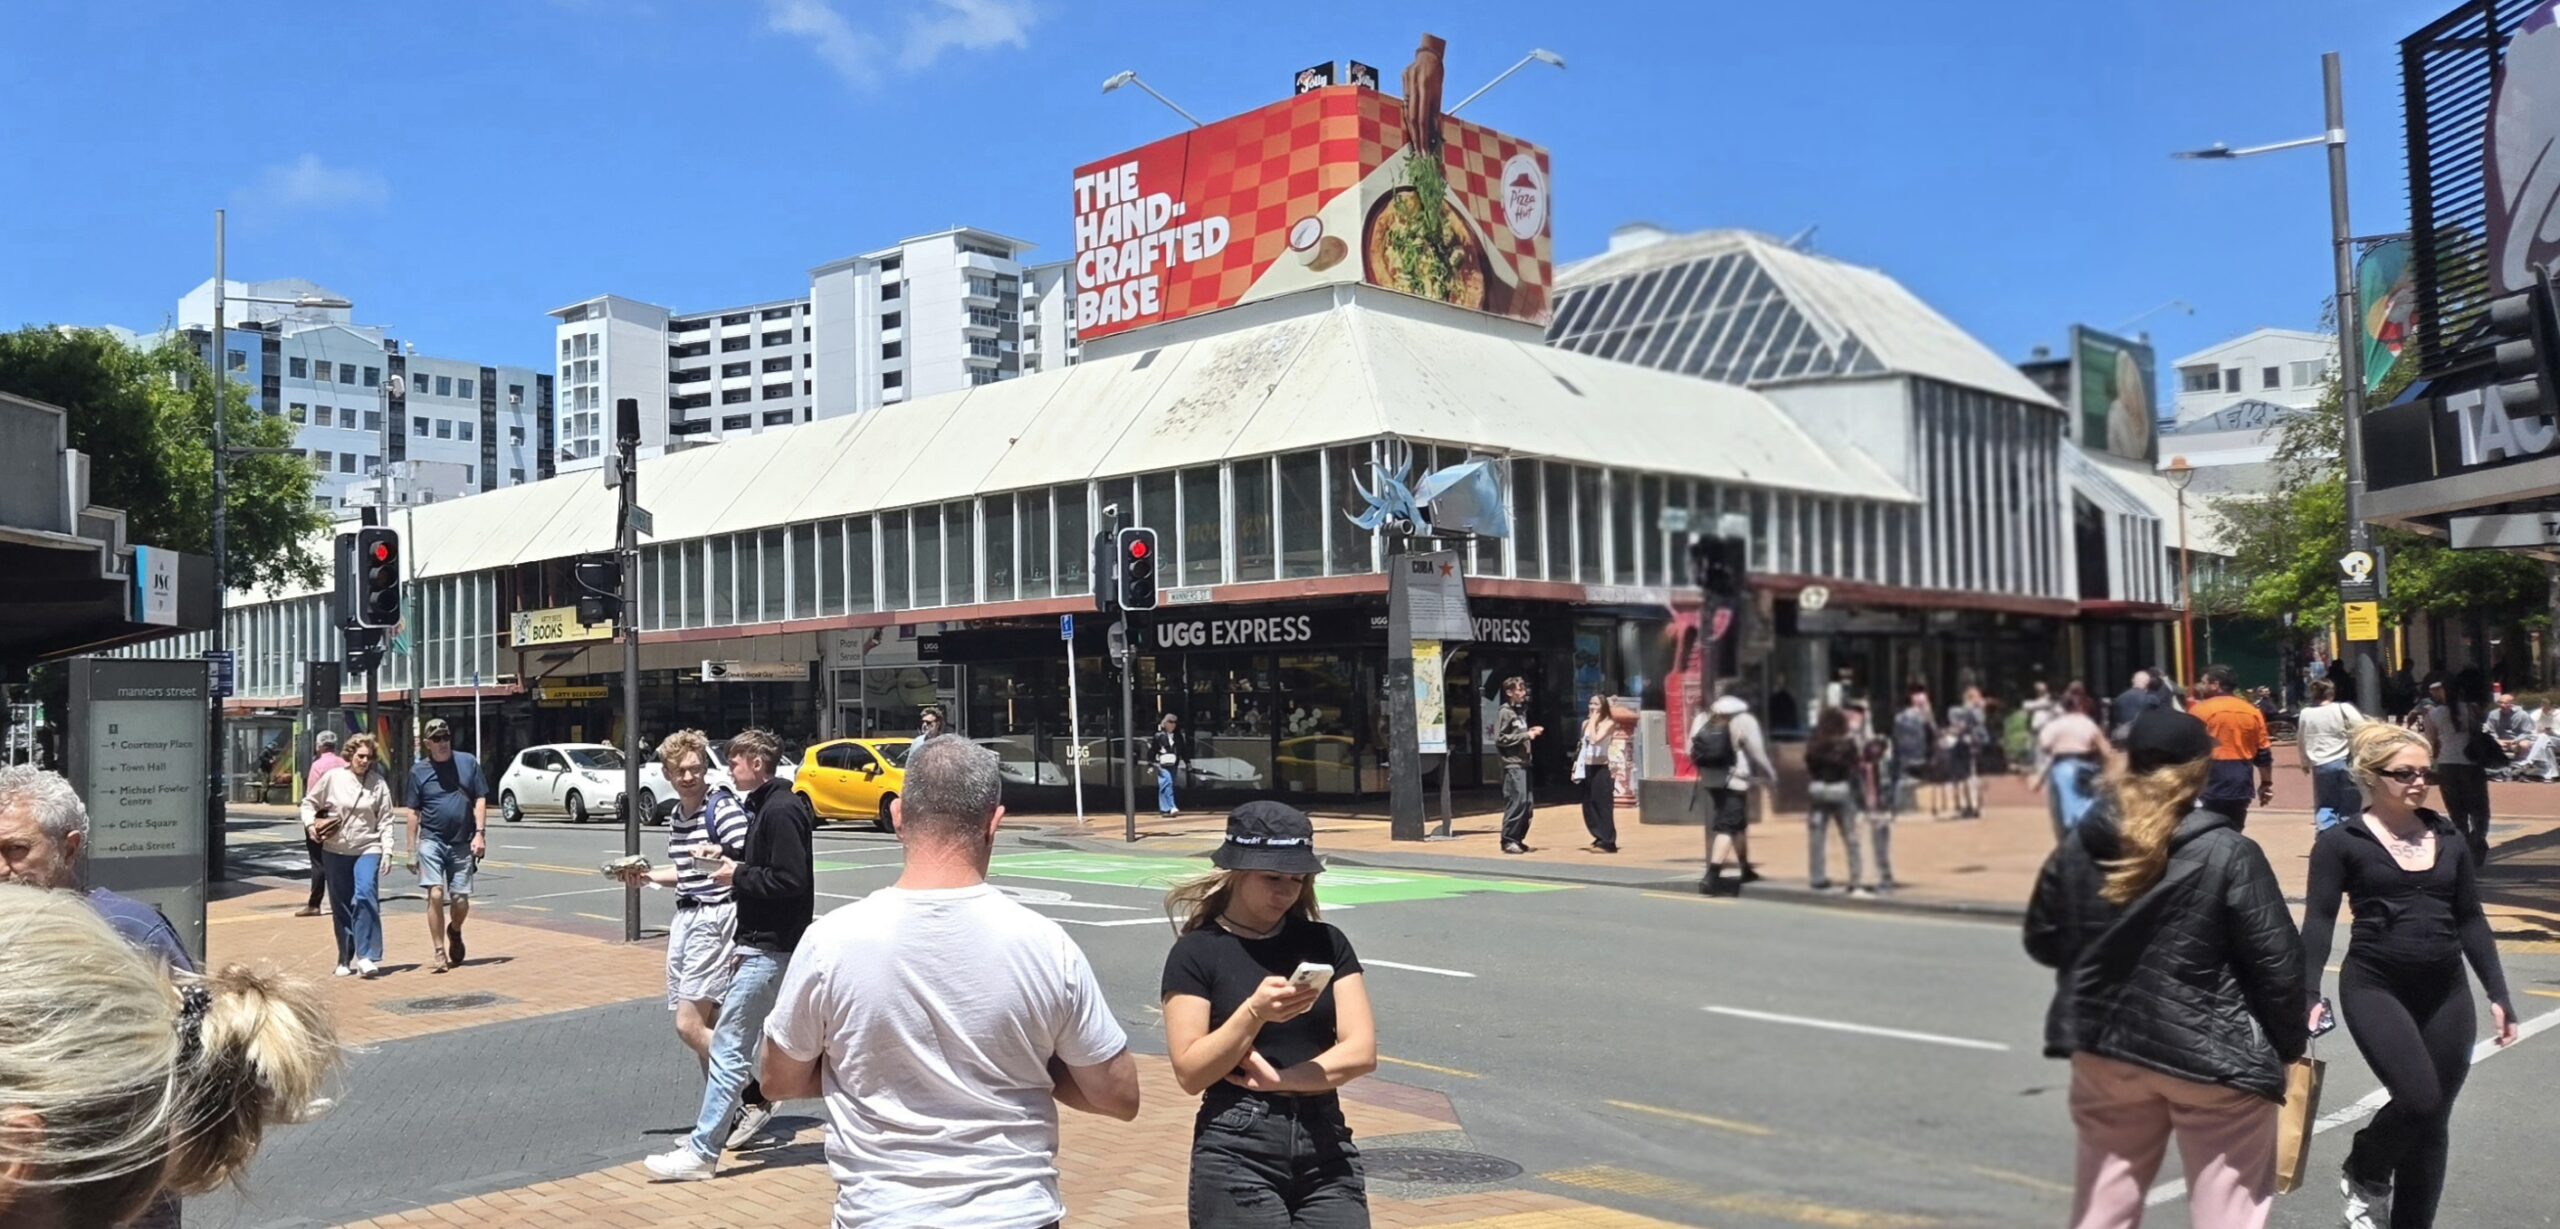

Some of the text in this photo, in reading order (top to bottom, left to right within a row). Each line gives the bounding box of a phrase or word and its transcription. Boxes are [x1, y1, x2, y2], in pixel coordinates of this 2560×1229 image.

[1075, 161, 1139, 213] THE
[1509, 189, 1536, 209] Pizza
[1076, 192, 1186, 253] HAND-
[1515, 206, 1534, 224] Hut
[1076, 216, 1230, 288] CRAFTED
[1078, 275, 1159, 331] BASE
[1412, 561, 1434, 574] CUBA
[153, 573, 170, 590] JSC
[1370, 616, 1388, 625] UGG
[533, 623, 563, 640] BOOKS
[1157, 615, 1312, 648] UGG EXPRESS
[1472, 617, 1531, 643] XPRESS
[840, 653, 860, 662] Service
[118, 687, 197, 697] manners street
[121, 740, 193, 750] Courtenay Place
[121, 763, 166, 772] Town Hall
[120, 785, 189, 795] Michael Fowler
[120, 798, 152, 807] Centre
[120, 819, 177, 829] Civic Square
[119, 841, 175, 852] Cuba Street
